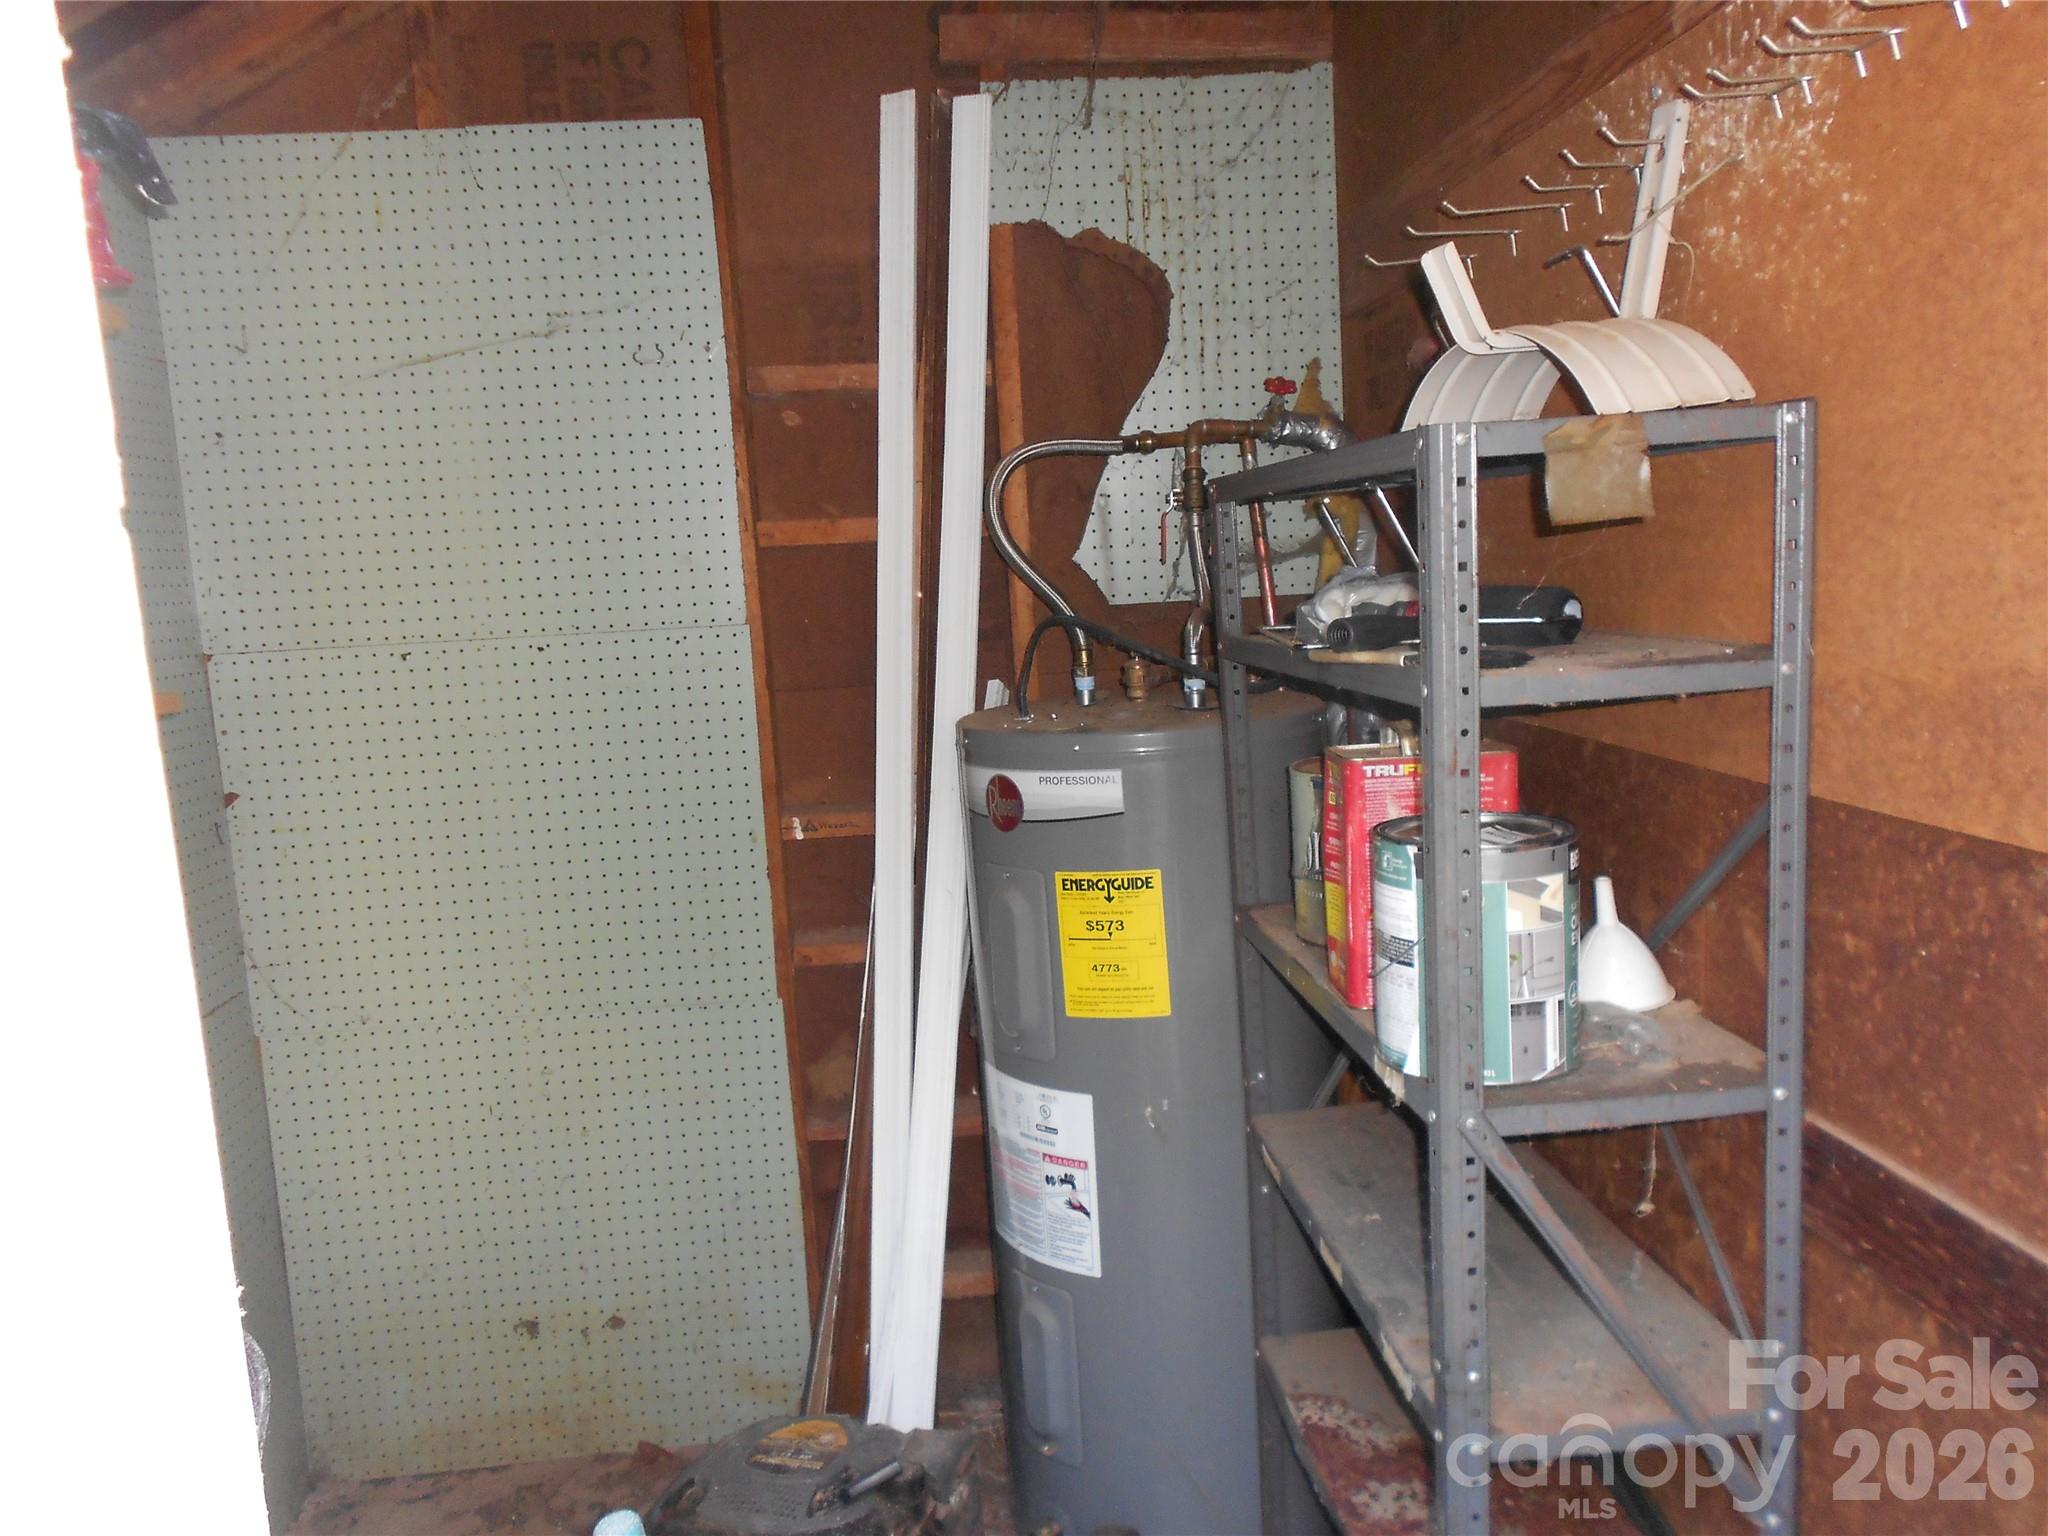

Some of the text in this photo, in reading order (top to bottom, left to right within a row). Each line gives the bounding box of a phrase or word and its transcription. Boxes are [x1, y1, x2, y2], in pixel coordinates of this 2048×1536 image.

[1038, 775, 1118, 786] PROFESSIONAL
[1061, 877, 1154, 895] ENERGYGUIDE
[1085, 920, 1125, 932] $573
[1091, 964, 1120, 973] 4773
